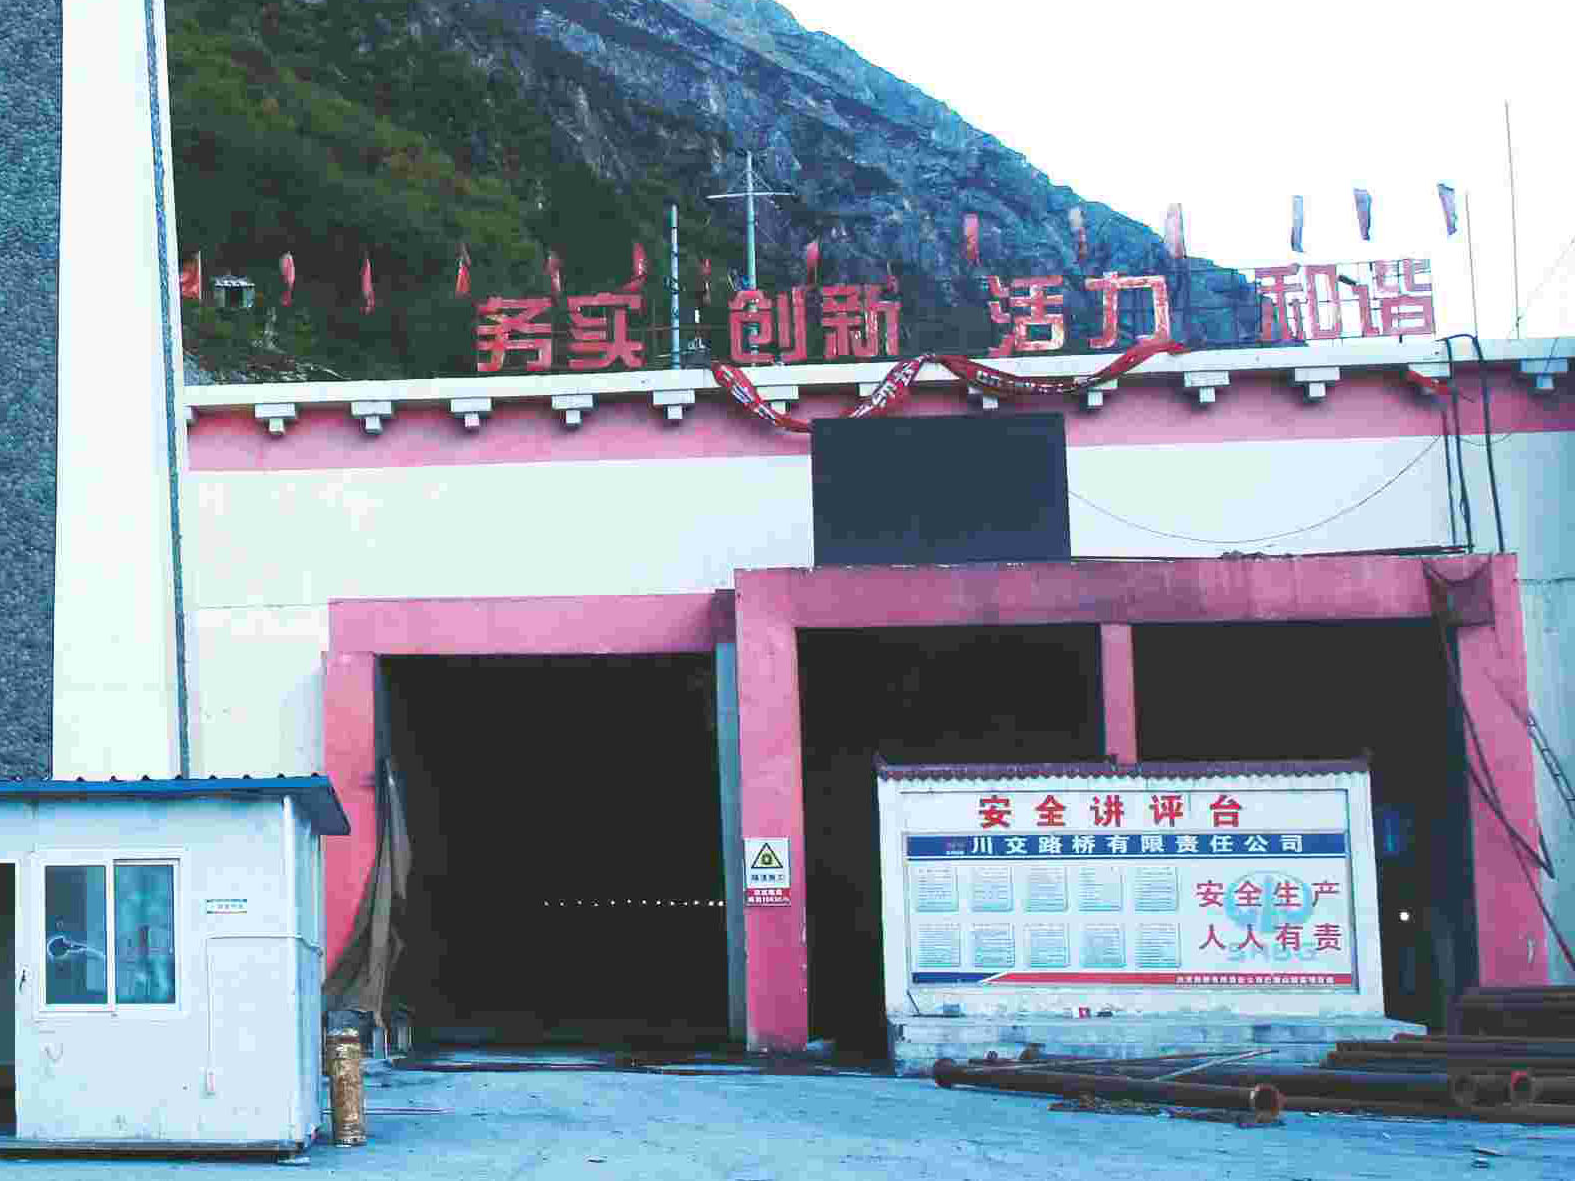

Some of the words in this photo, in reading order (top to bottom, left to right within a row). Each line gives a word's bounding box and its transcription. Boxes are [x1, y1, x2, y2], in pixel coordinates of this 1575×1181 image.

[475, 292, 646, 372] 务实
[727, 282, 902, 363] 创新
[987, 271, 1172, 358] 活力
[1254, 258, 1437, 341] 和谐
[978, 794, 1243, 828] 安全讲评台
[971, 835, 1304, 854] 川交路桥有限责任公司
[1196, 879, 1340, 908] 安全生产
[1198, 923, 1343, 952] 人人有责
